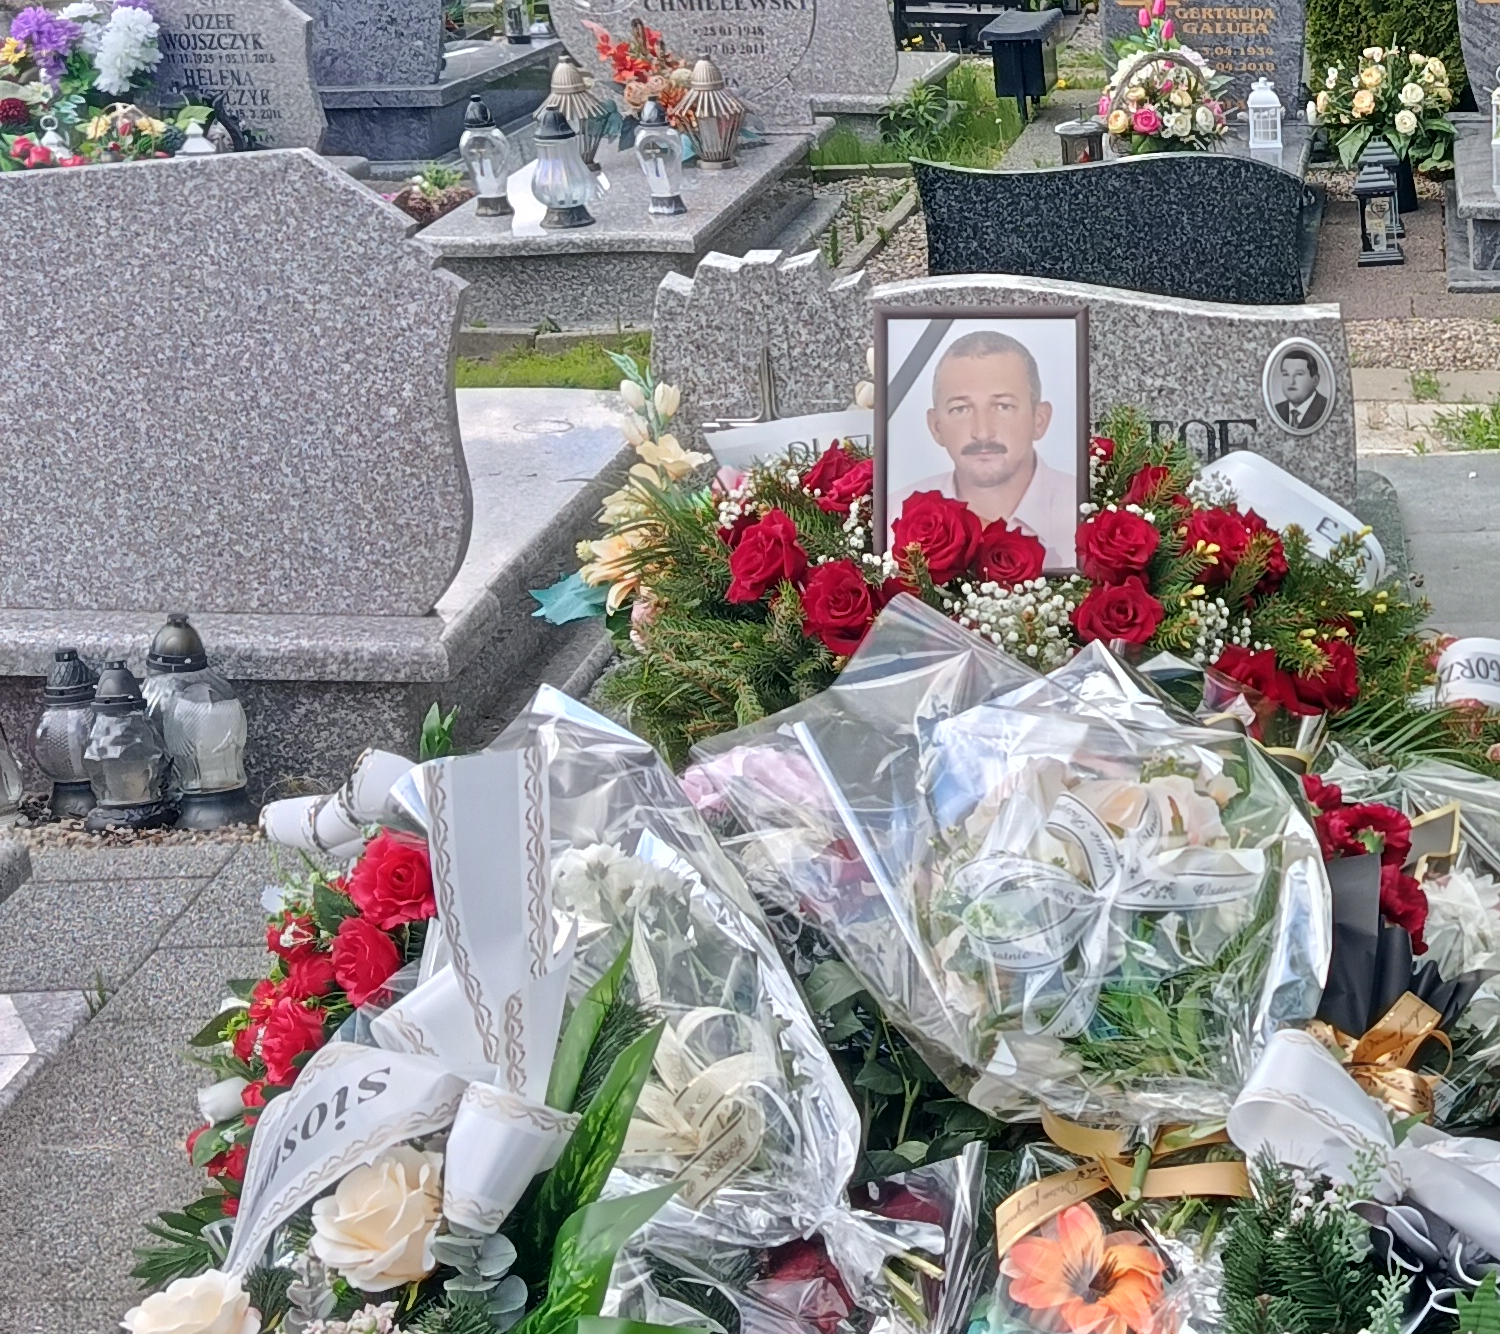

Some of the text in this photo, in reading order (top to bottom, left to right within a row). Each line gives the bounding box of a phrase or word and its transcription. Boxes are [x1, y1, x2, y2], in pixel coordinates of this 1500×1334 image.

[1174, 6, 1276, 21] GERTRUDA
[161, 33, 264, 51] WOJSZCZYK
[183, 68, 254, 86] HELENA
